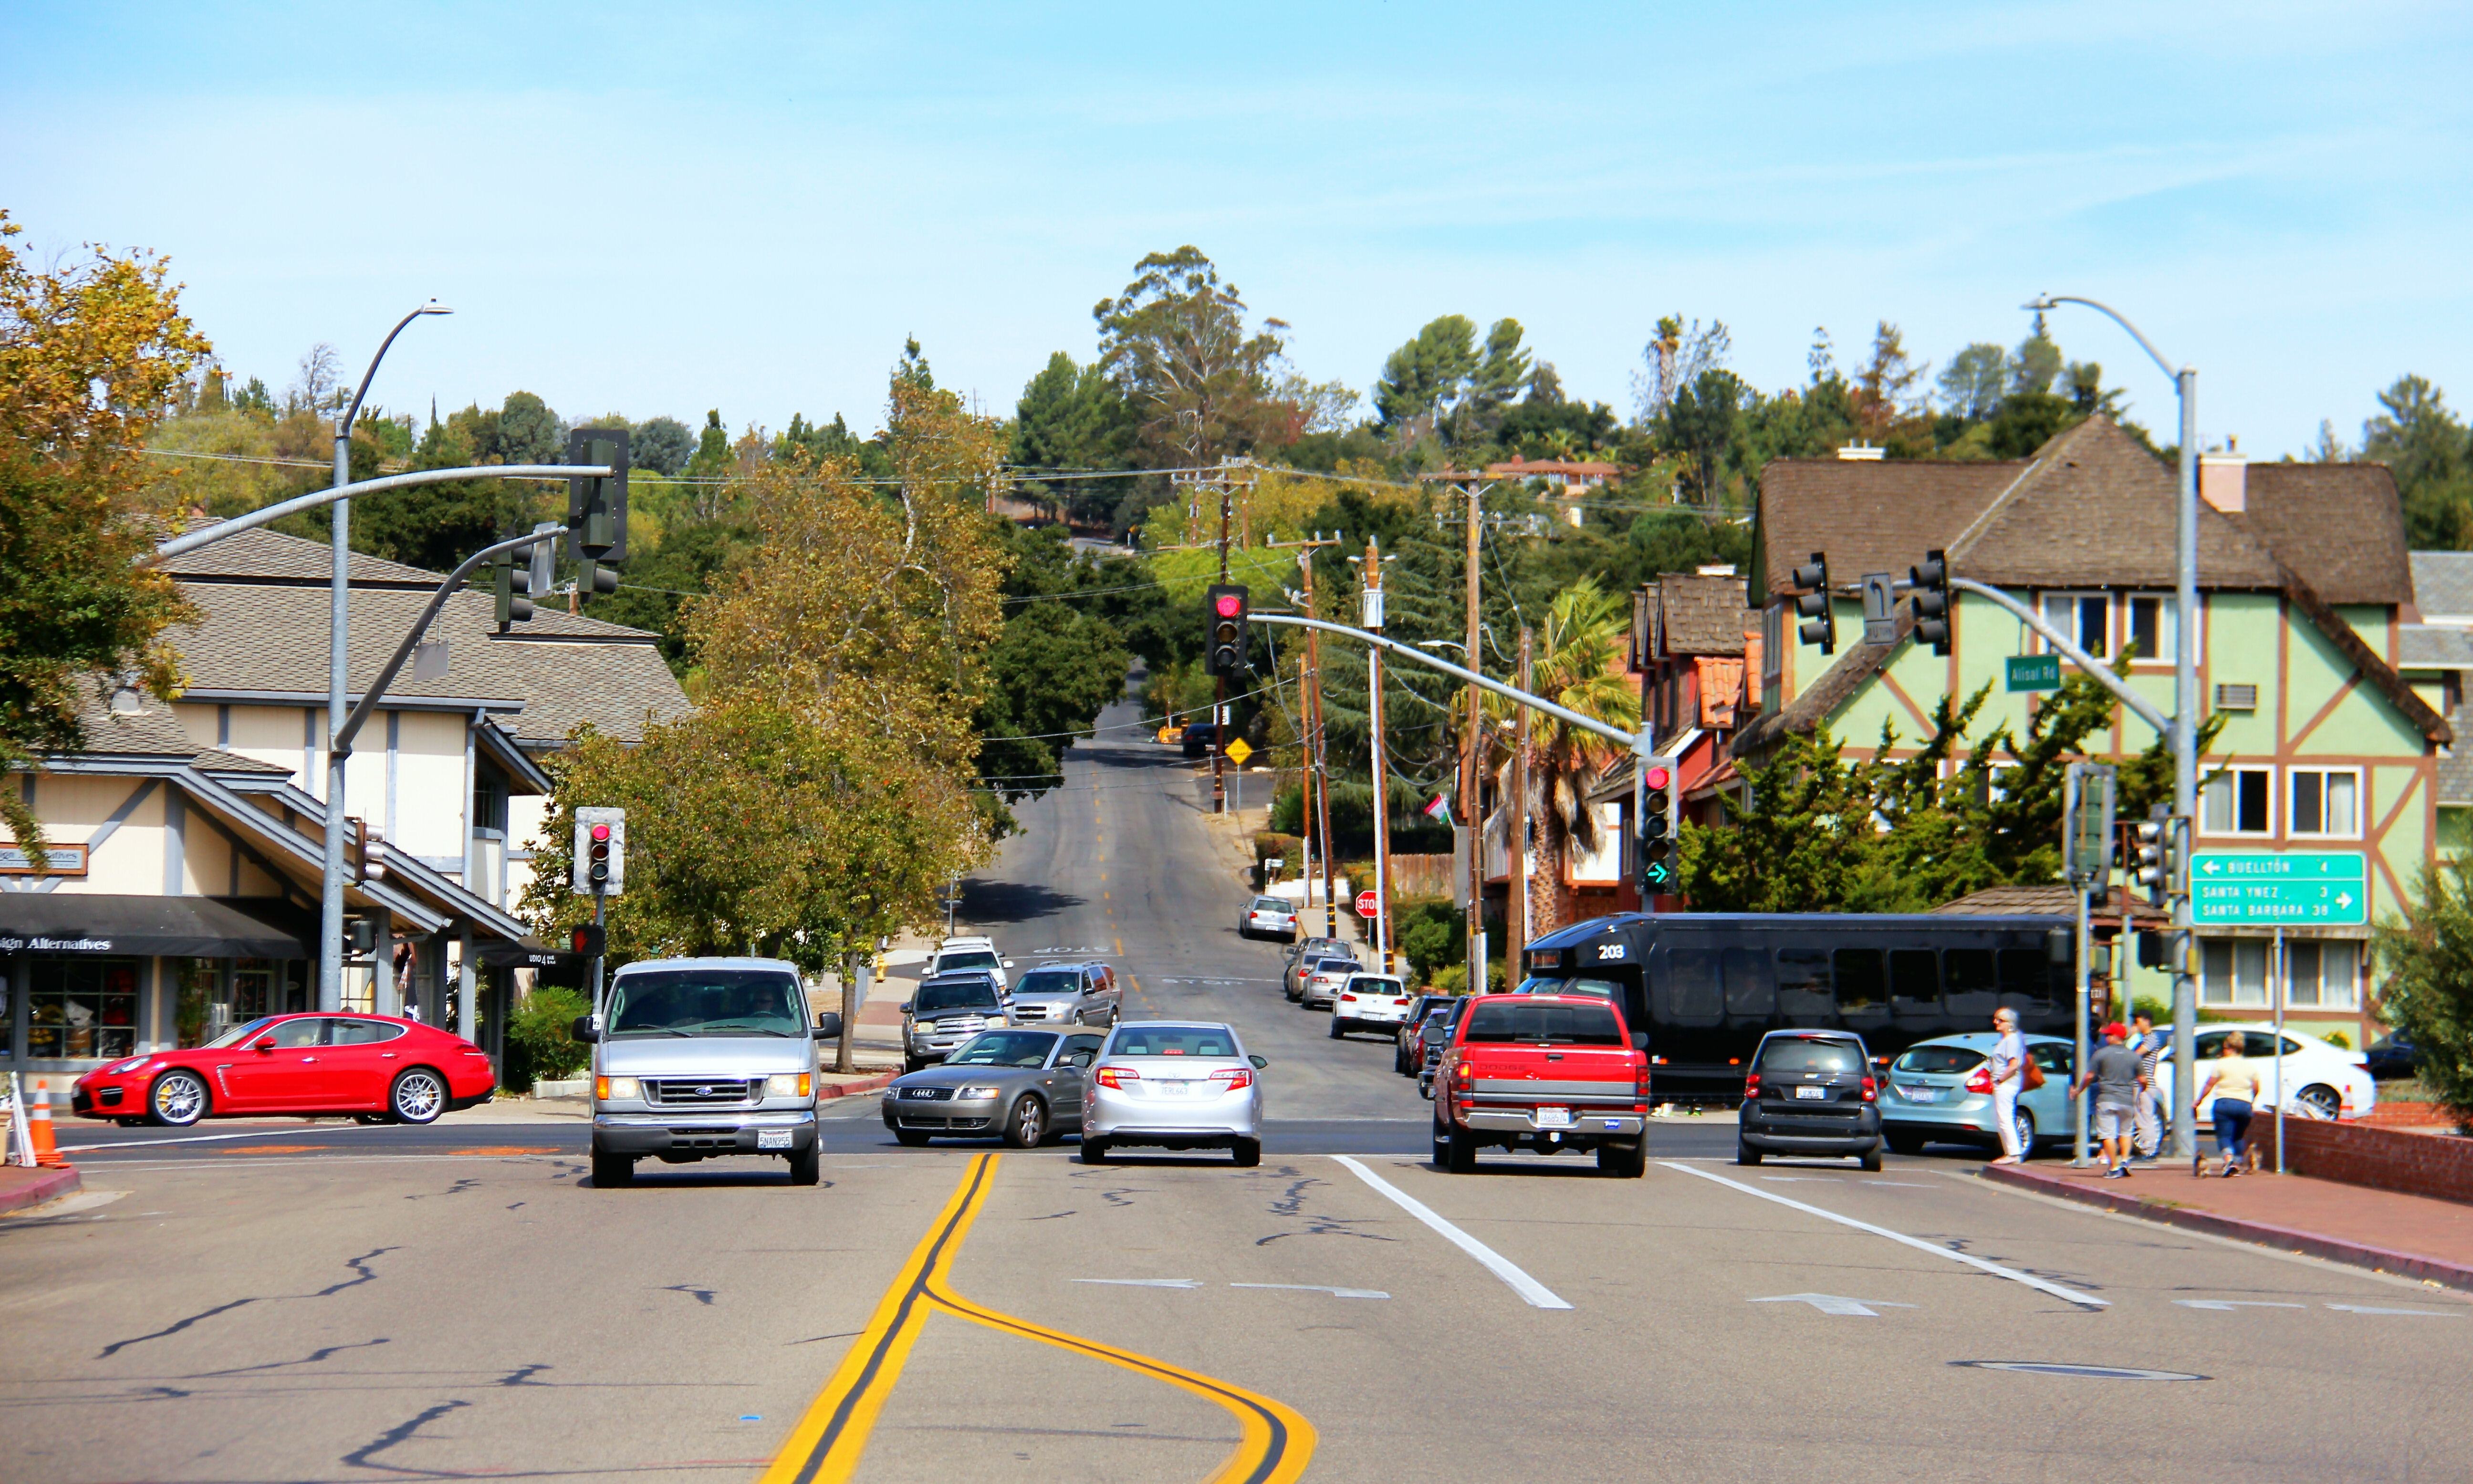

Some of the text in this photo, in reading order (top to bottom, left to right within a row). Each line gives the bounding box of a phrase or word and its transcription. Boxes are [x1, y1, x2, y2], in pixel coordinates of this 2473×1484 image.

[2012, 665, 2055, 682] Alisal Rd
[2319, 861, 2327, 872] 4
[2202, 887, 2327, 898] SANTA YNEZ 3
[1358, 899, 1376, 910] STO
[2202, 905, 2240, 916] SANTA
[2247, 905, 2304, 916] BARBARA
[27, 937, 111, 950] Alternatives
[1598, 945, 1624, 959] 203
[760, 1137, 790, 1146] 5NAN255
